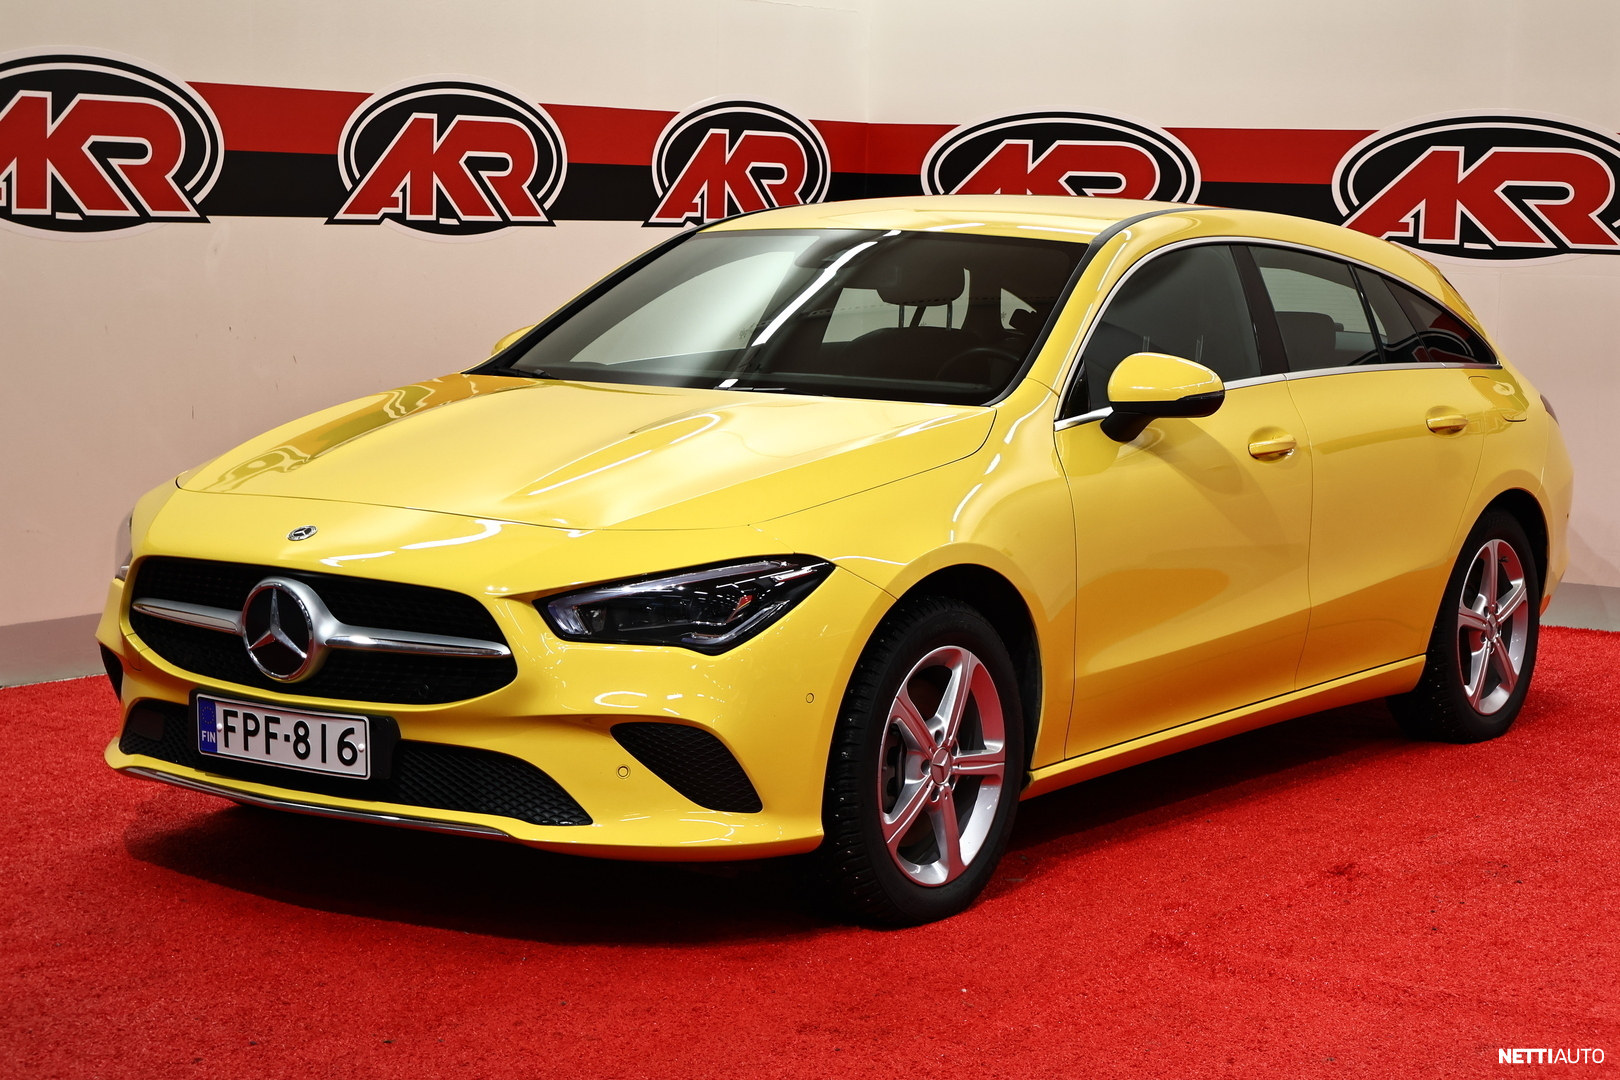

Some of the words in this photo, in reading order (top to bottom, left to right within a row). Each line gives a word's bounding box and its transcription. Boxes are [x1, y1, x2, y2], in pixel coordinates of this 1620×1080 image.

[333, 112, 549, 222] AKR
[648, 128, 808, 223] AKR
[1341, 146, 1620, 249] AKR
[201, 730, 216, 743] FIN
[222, 709, 358, 766] FPF-816
